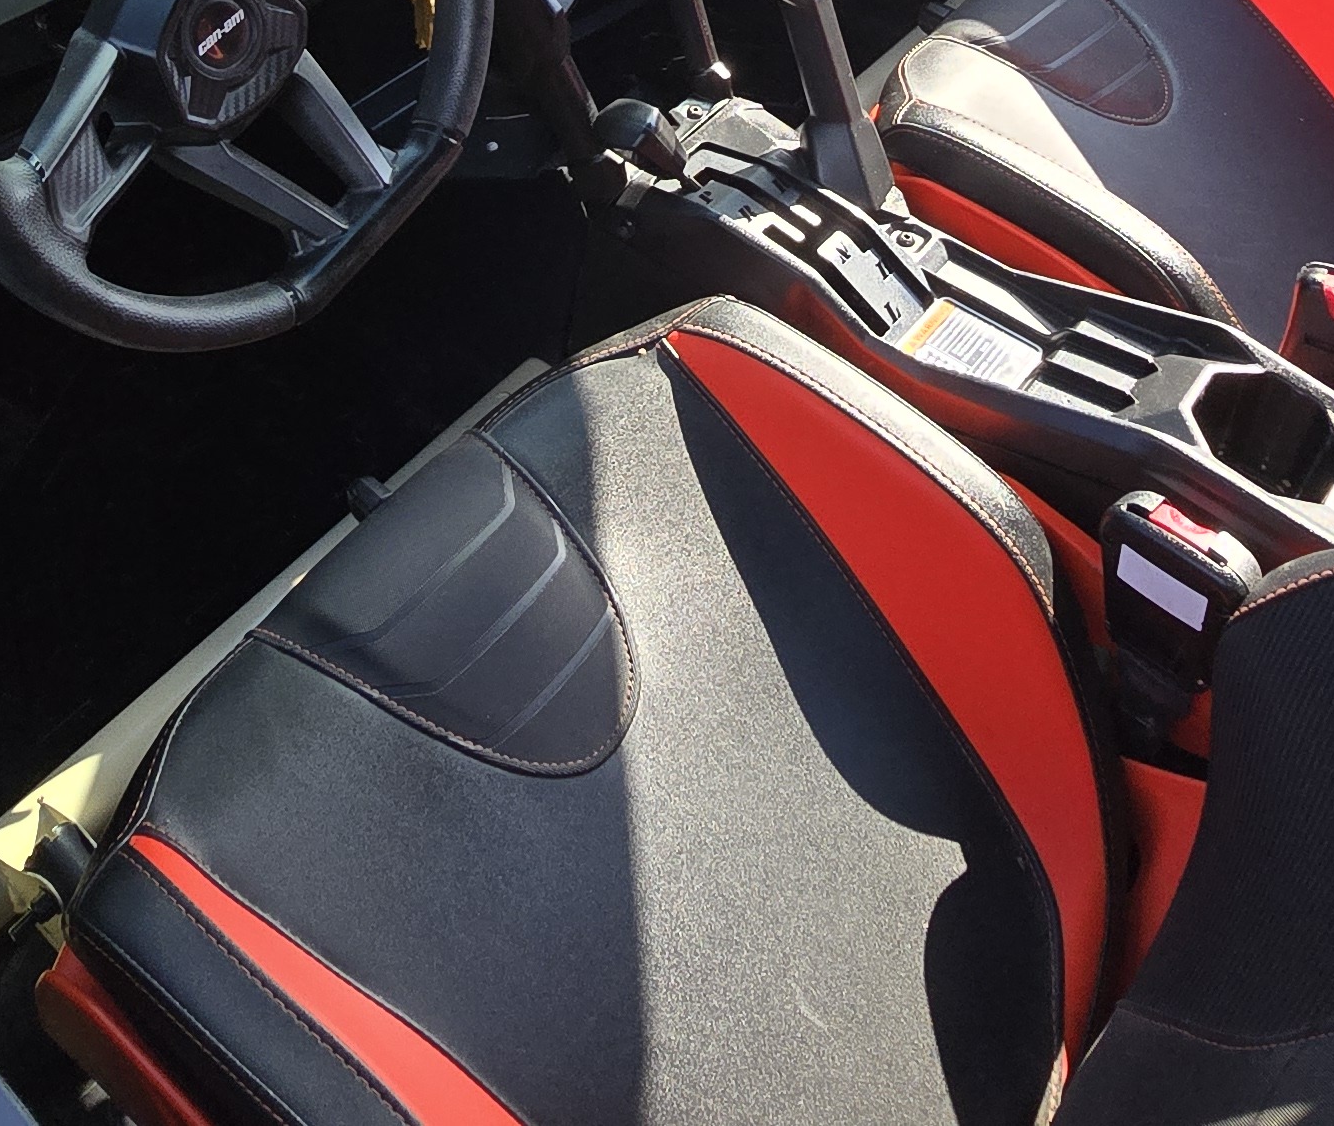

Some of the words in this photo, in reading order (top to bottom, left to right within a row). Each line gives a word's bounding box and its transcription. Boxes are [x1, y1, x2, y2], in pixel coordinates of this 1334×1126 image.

[198, 8, 245, 56] can-am
[699, 190, 713, 205] P
[883, 301, 902, 325] L
